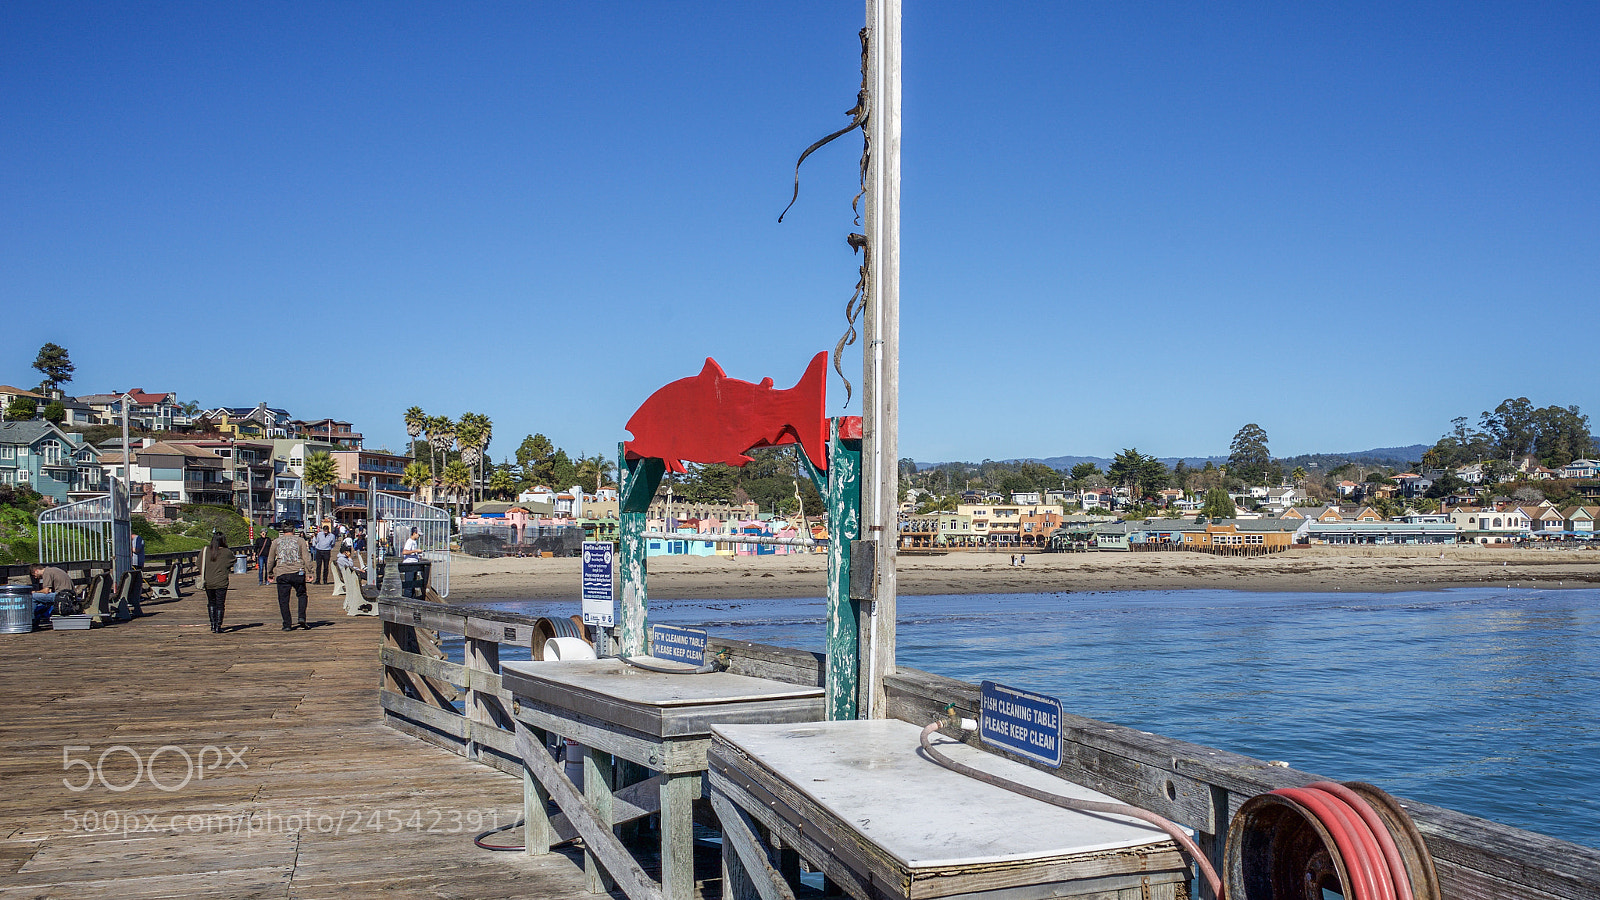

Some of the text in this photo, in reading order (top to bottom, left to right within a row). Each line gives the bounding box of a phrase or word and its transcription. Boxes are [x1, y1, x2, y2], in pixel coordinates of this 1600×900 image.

[665, 633, 688, 645] CLEANING
[689, 637, 704, 647] TABLE
[655, 645, 702, 660] PLEASE KEEP CLEAN
[983, 695, 1057, 729] FISH CLEANING TABLE
[984, 715, 1055, 751] PLEASE KEEP CLEAN
